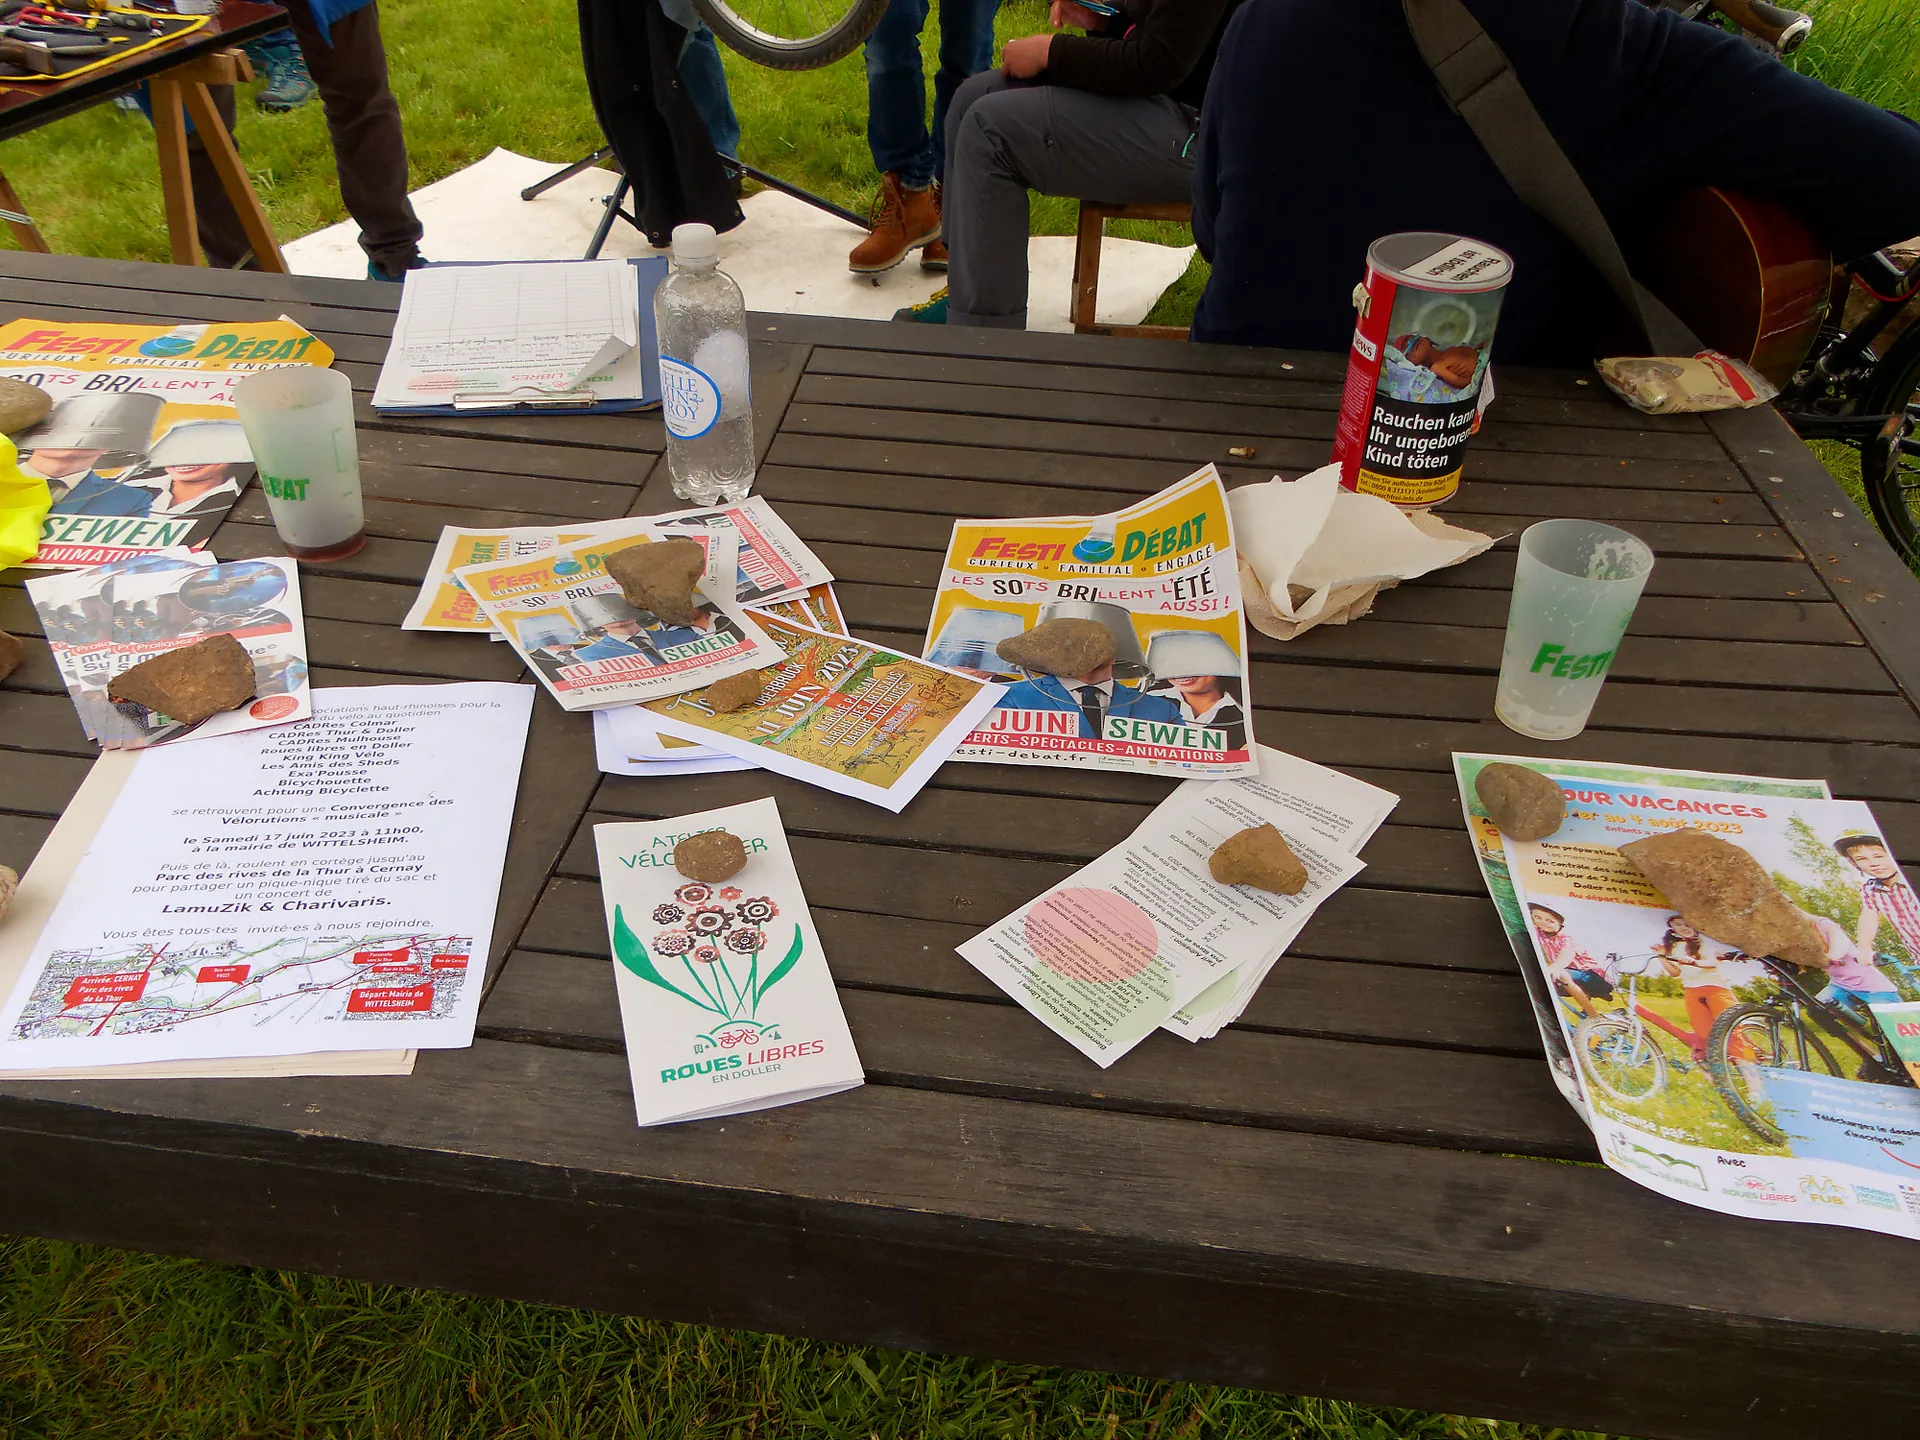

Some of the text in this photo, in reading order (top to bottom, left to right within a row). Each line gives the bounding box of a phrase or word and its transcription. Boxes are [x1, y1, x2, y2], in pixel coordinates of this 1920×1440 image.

[109, 357, 200, 368] FAMILIAL
[83, 374, 216, 392] BRILLENT
[1373, 406, 1444, 430] Rauchen
[1370, 426, 1392, 444] Ihr
[1366, 445, 1448, 468] Kind töten
[41, 517, 188, 546] SEWEN
[970, 545, 1212, 574] CURIEUX FAMILIAL ENGAGÉ
[494, 570, 602, 596] CURIEUX FAMILIAL
[952, 566, 1213, 601] LES SOTS BRILLENT L'ÉTÉ
[522, 594, 560, 608] SOTS
[1160, 598, 1217, 611] AUSSI
[137, 638, 192, 649] Pratiquez
[664, 632, 737, 661] SEWEN
[563, 656, 648, 679] 10 JUIN
[776, 681, 824, 718] JUIN
[815, 646, 859, 681] 2023
[814, 676, 877, 732] MARCHÉ PAYSAN
[819, 718, 854, 746] MARCHÉ
[849, 705, 869, 719] DES
[864, 671, 900, 704] ARTISANS
[840, 681, 911, 746] MARCHÉ AUX PUCES
[991, 710, 1067, 733] JUIN
[269, 731, 320, 739] CADRes
[336, 735, 401, 743] Mulhouse
[1109, 718, 1222, 749] SEWEN
[956, 748, 1086, 762] esti-debat.fr
[289, 769, 367, 778] Exa'Pousse
[278, 778, 371, 787] Bicychouette
[253, 785, 390, 796] Achtung Bicyclette
[330, 801, 424, 811] Convergence
[1619, 794, 1767, 819] VACANCES
[222, 811, 389, 824] Vélorutions musicale
[1604, 813, 1742, 834] au 4 août 2023
[202, 835, 259, 843] Samedi
[284, 832, 314, 841] juin
[375, 826, 424, 835] 11h00,
[302, 837, 408, 847] WITTELSHEIM.
[1562, 846, 1617, 857] préparation
[313, 857, 364, 865] cortège
[367, 854, 425, 864] jusqu'au
[1550, 862, 1590, 870] contrôle
[132, 878, 341, 893] pour partager pique-nique
[1554, 871, 1584, 879] séjour
[1611, 878, 1648, 887] nuitées
[1573, 882, 1603, 891] Doller
[258, 890, 310, 898] concert
[1585, 894, 1620, 902] départ
[162, 897, 391, 913] LamuZik & Charivaris.
[143, 928, 173, 936] êtes
[366, 919, 433, 929] rejoindre.
[114, 974, 143, 982] CERNAY
[660, 1040, 824, 1083] ROUES LIBRES
[712, 1064, 781, 1084] EN DOLLER
[1717, 1155, 1746, 1168] Avec
[1760, 1194, 1797, 1203] LIBRES
[1810, 1193, 1844, 1205] FUB
